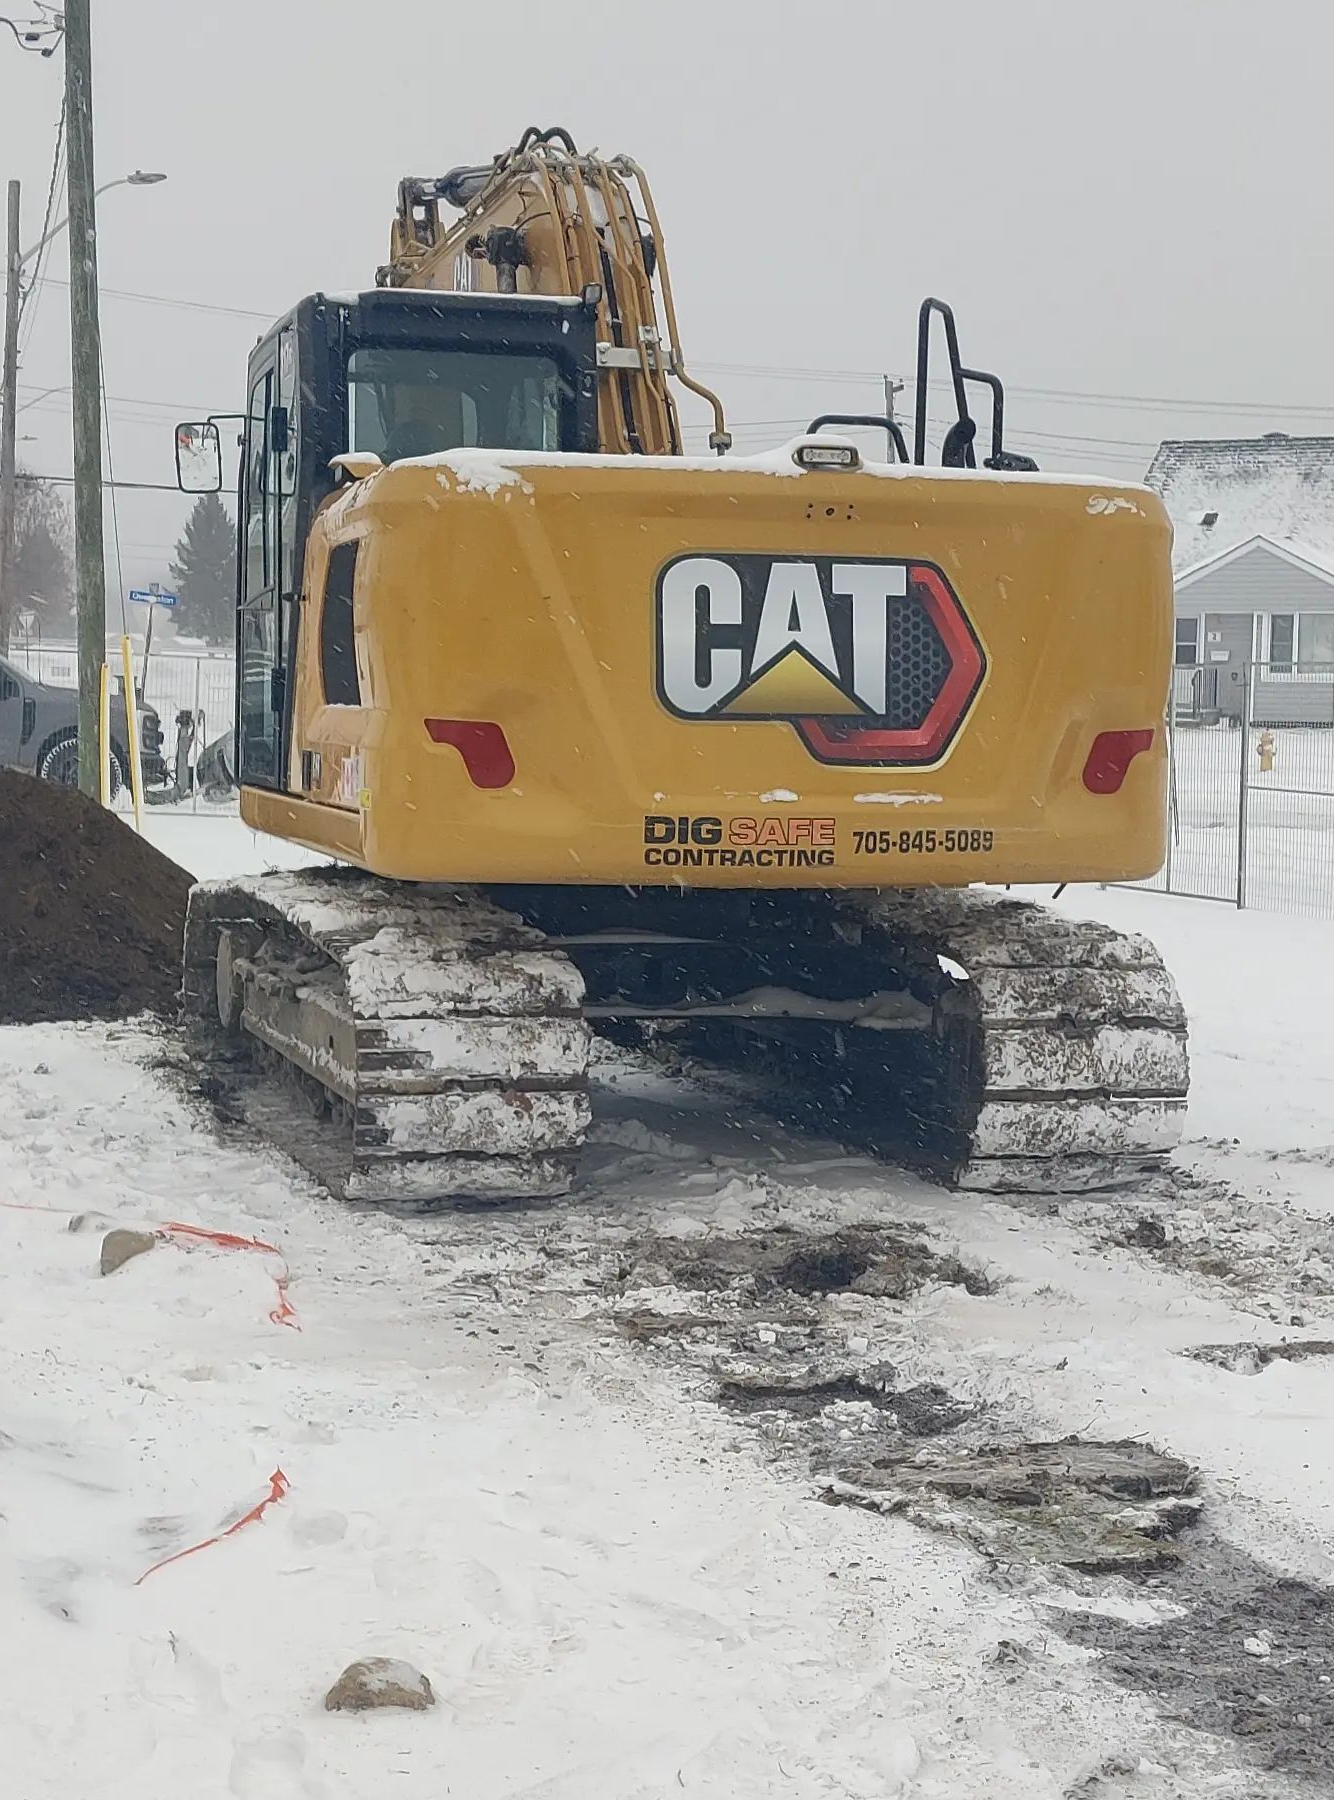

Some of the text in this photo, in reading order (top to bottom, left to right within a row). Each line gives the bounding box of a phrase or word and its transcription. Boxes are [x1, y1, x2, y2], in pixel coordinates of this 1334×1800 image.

[132, 591, 174, 605] Queston
[662, 558, 907, 715] CAT
[644, 816, 836, 846] DIG SAFE
[852, 829, 994, 854] 705-845-5089
[644, 848, 835, 867] CONTRACTING
